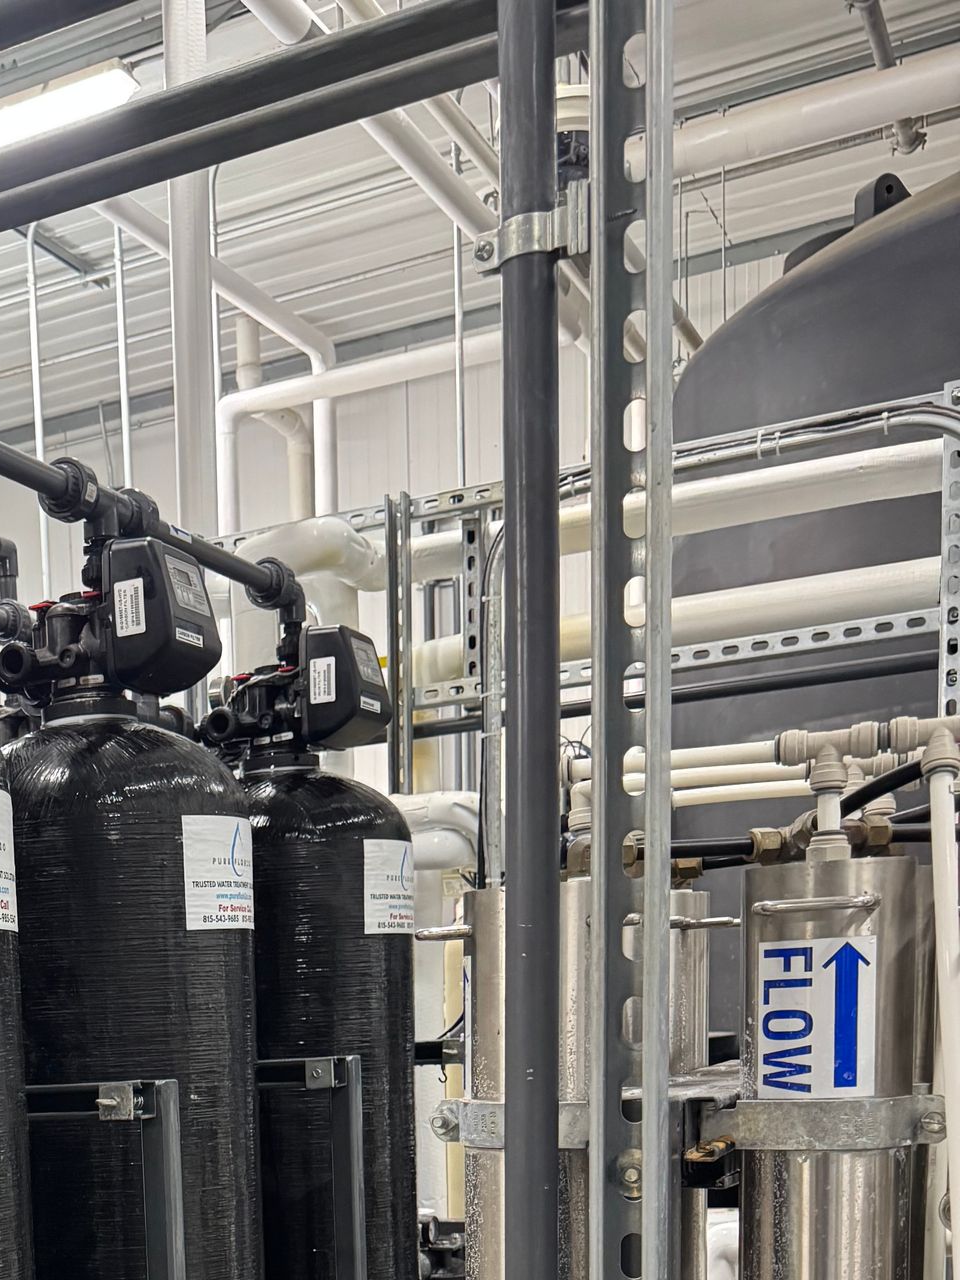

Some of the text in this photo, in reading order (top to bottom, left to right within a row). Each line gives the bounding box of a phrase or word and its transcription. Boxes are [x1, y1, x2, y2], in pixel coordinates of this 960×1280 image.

[0, 899, 9, 910] Call
[218, 904, 229, 912] For
[762, 946, 814, 1094] FLOW
